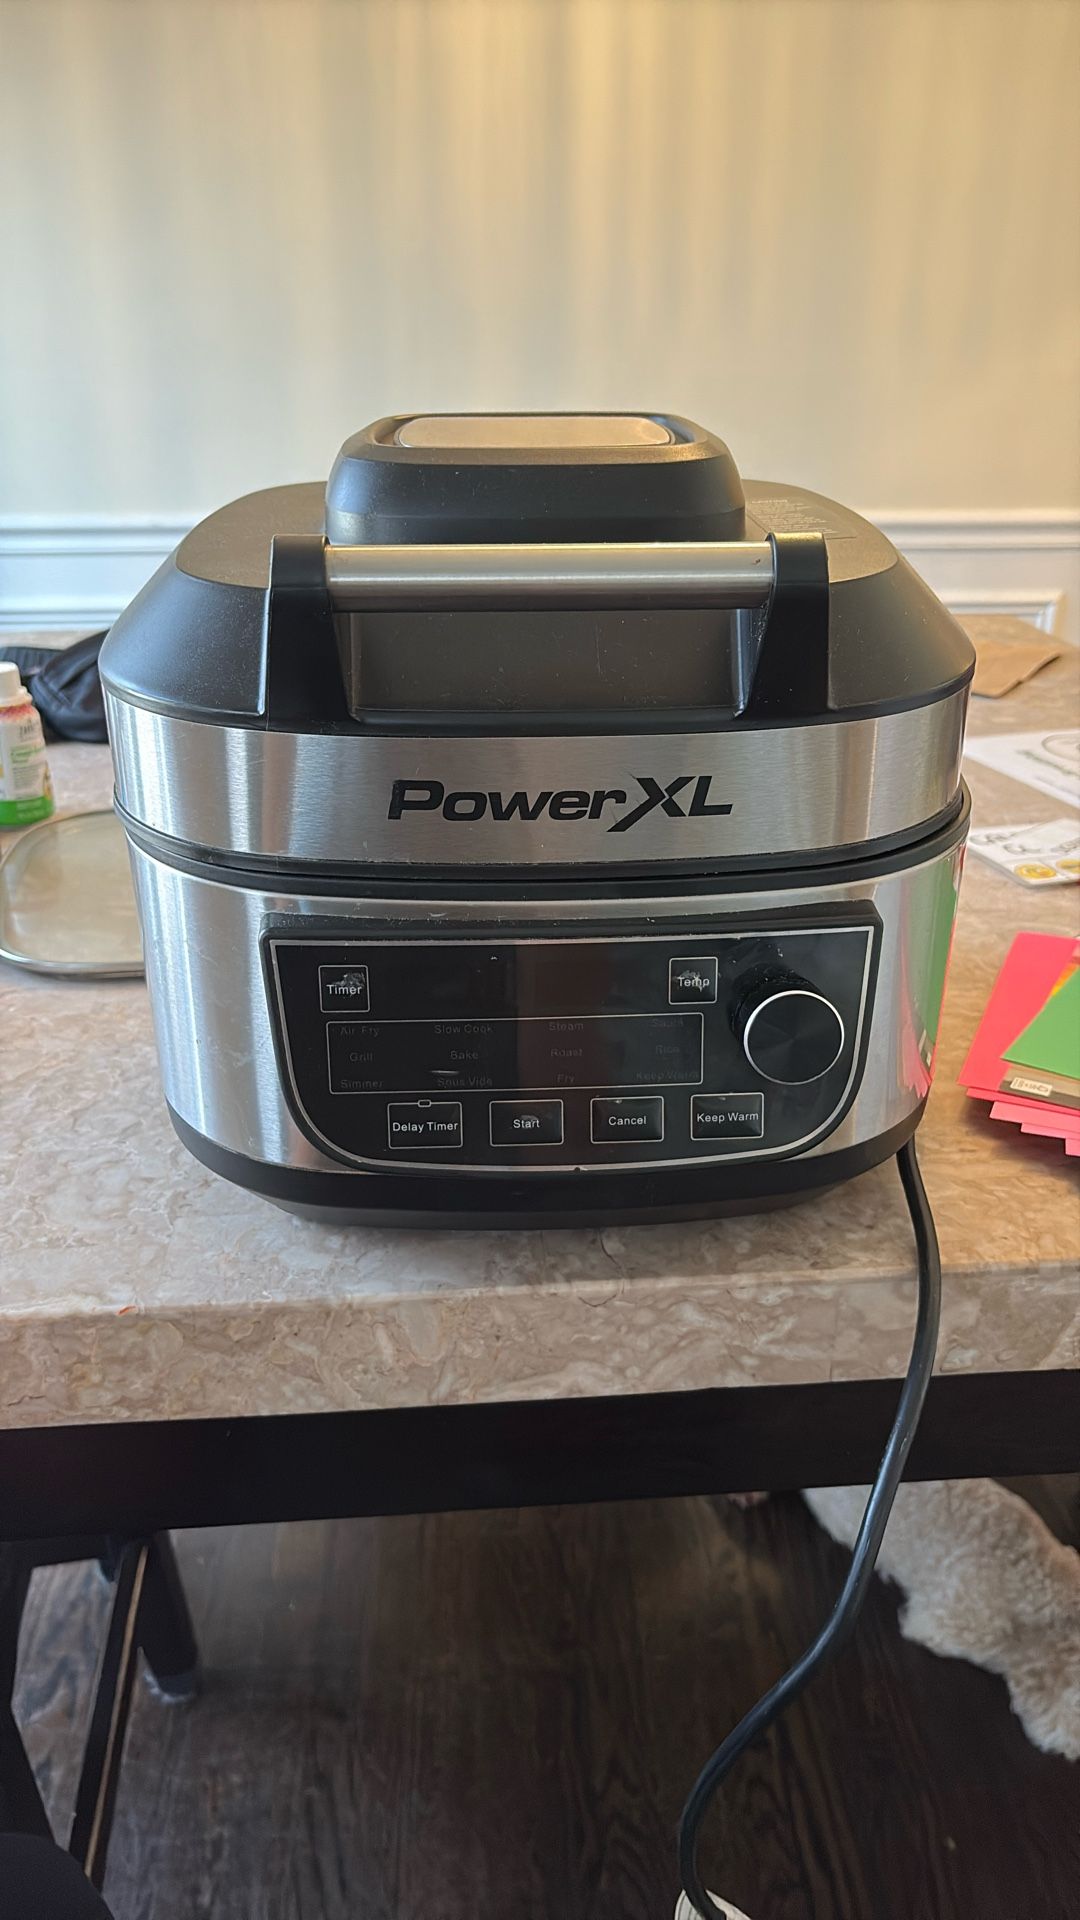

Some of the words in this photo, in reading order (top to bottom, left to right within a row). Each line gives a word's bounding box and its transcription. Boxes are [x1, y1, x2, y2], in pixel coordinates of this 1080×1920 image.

[677, 976, 710, 989] Temp
[326, 984, 363, 996] Timer
[340, 1026, 357, 1036] Air
[361, 1025, 380, 1038] Fry
[434, 1024, 461, 1034] Slow
[464, 1023, 493, 1034] Cook
[549, 1021, 584, 1031] Steam
[350, 1052, 373, 1062] Grill
[450, 1050, 479, 1060] Bake
[550, 1047, 583, 1057] Roast
[341, 1079, 383, 1089] Simmer
[557, 1074, 575, 1085] Fry
[608, 1114, 647, 1126] Cancel
[697, 1111, 725, 1123] Keep
[728, 1110, 759, 1122] Warm
[392, 1121, 424, 1134] Delay
[426, 1120, 458, 1131] Timer
[513, 1118, 540, 1129] Start
